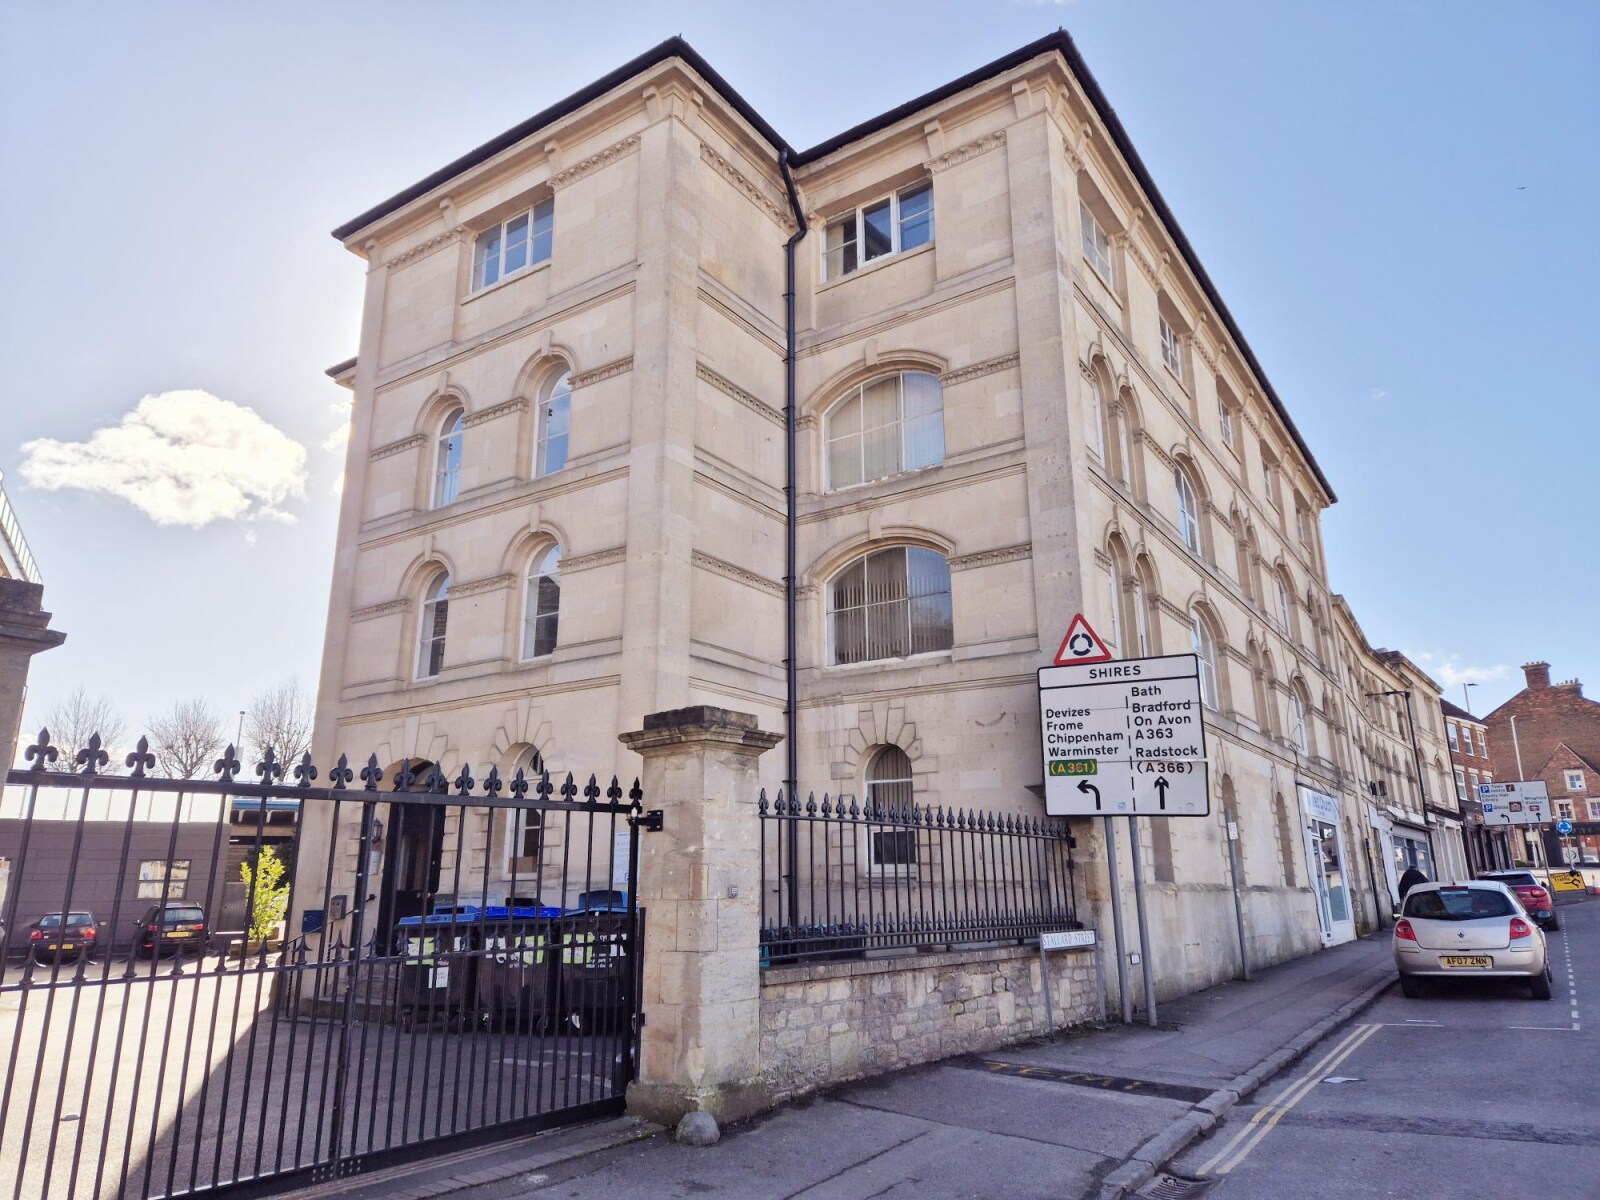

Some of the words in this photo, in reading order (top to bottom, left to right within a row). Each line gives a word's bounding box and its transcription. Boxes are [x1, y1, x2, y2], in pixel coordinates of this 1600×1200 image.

[1089, 665, 1141, 679] SHIRES
[1131, 686, 1162, 697] Bath
[1132, 700, 1191, 713] Bradford
[1046, 708, 1091, 719] Devizes
[1046, 721, 1083, 731] Frome
[1134, 716, 1152, 727] On
[1158, 715, 1191, 726] Avon
[1047, 731, 1124, 745] Chippenham
[1135, 728, 1173, 740] A363
[1048, 745, 1119, 757] Warminster
[1135, 745, 1198, 758] Radstock
[1136, 761, 1193, 774] (A366)
